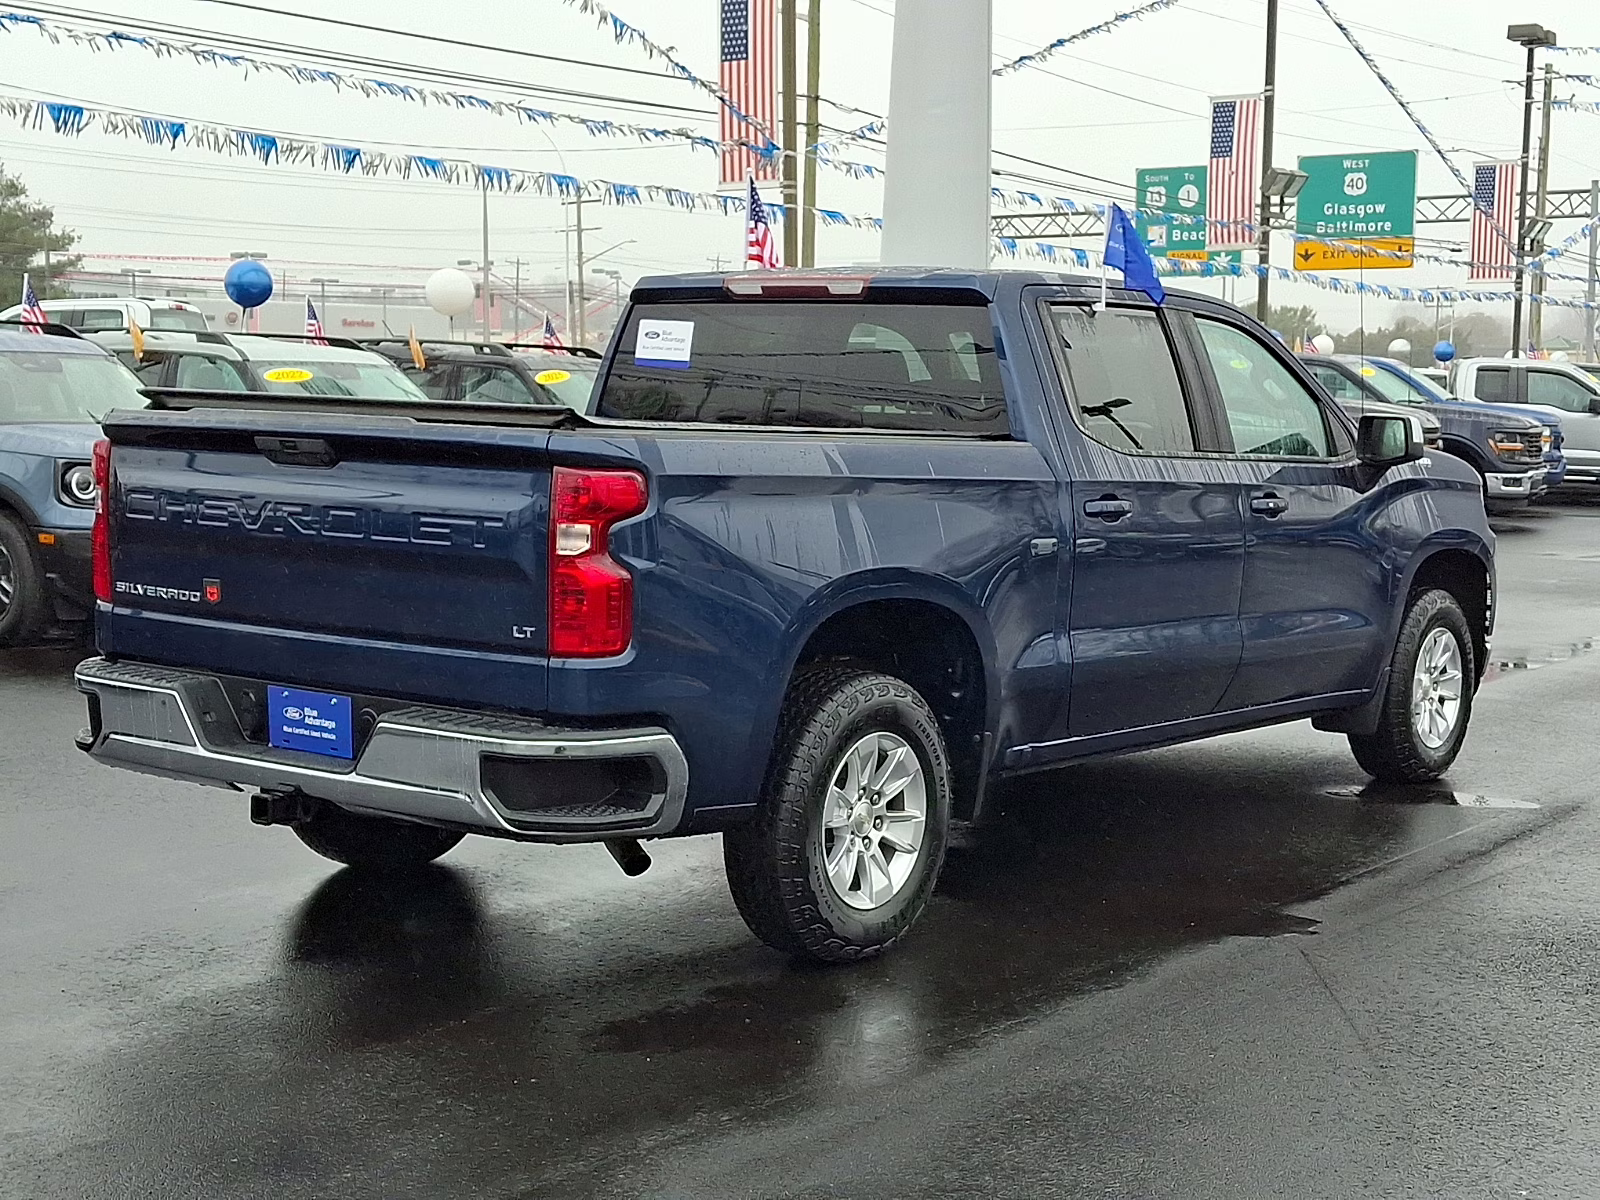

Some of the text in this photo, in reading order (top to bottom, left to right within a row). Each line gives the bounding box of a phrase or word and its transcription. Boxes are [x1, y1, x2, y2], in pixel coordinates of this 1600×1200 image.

[1342, 160, 1370, 169] WEST
[1145, 173, 1195, 183] SOUTH TO
[1346, 177, 1364, 190] 40
[1149, 190, 1162, 203] 13
[1323, 203, 1386, 218] Glasgow
[1316, 220, 1392, 233] Baltimore
[1322, 250, 1345, 259] EXIT
[126, 488, 503, 548] CHEVROLET
[115, 581, 201, 603] SILVERADO
[512, 625, 536, 638] LT
